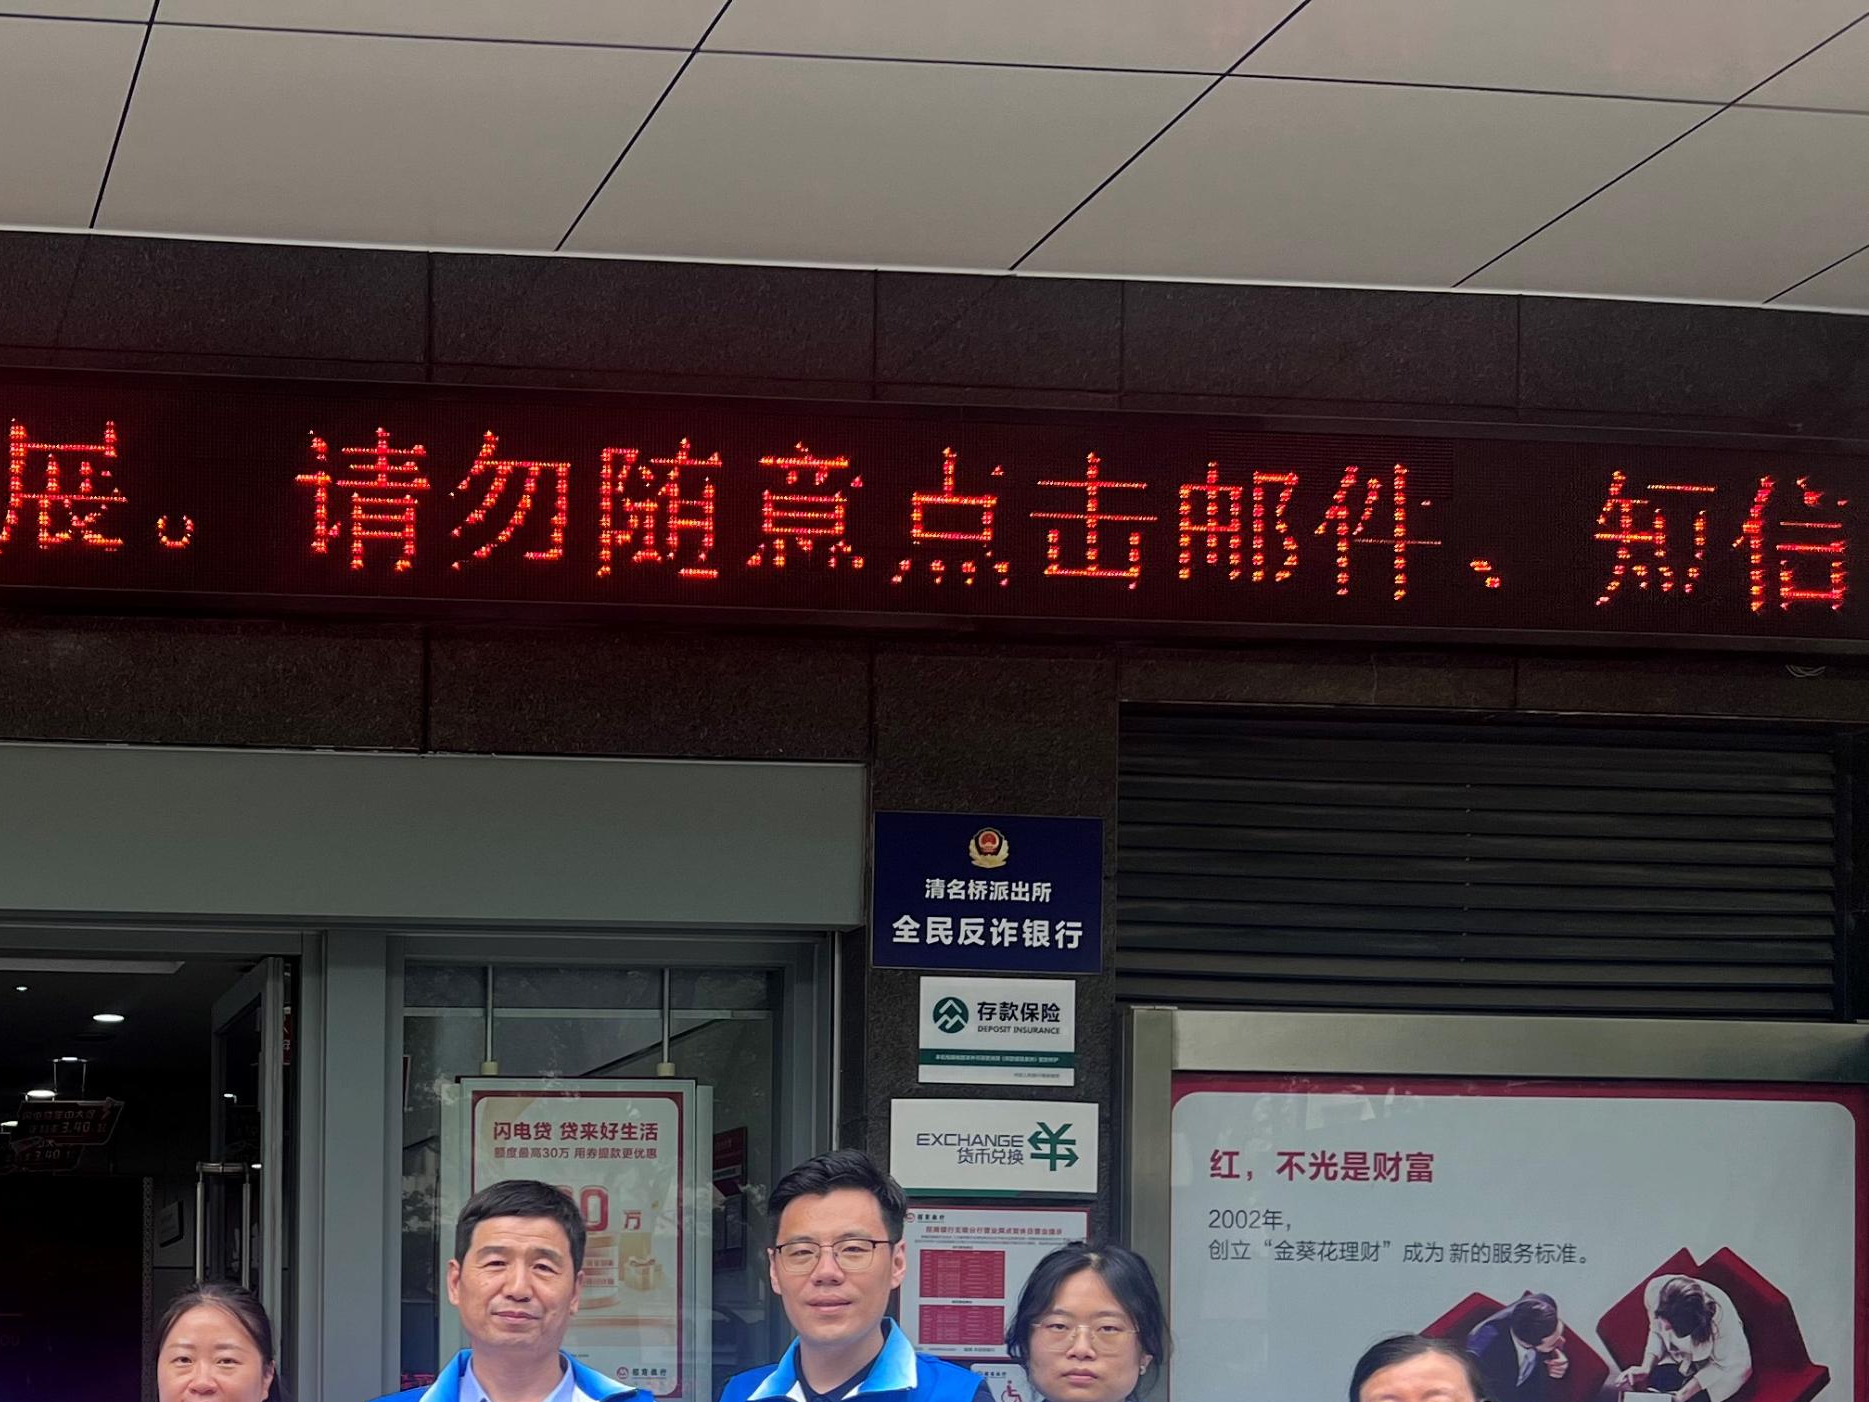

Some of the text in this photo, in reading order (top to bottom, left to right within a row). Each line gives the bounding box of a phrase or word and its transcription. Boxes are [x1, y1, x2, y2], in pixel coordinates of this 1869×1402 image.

[925, 878, 1052, 904] 清名桥派出所
[892, 914, 1083, 950] 全民反诈银行
[977, 1001, 1061, 1023] 存款保险
[978, 1025, 1060, 1035] DEPOSIT INSURANCE
[493, 1121, 659, 1141] 闪电贷 贷来好生活
[916, 1132, 1024, 1148] EXCHANGE
[494, 1147, 658, 1159] 额度最高30万 用券提款更优惠
[957, 1147, 1025, 1165] 货币兑换
[1210, 1149, 1434, 1183] 红，不光是财富
